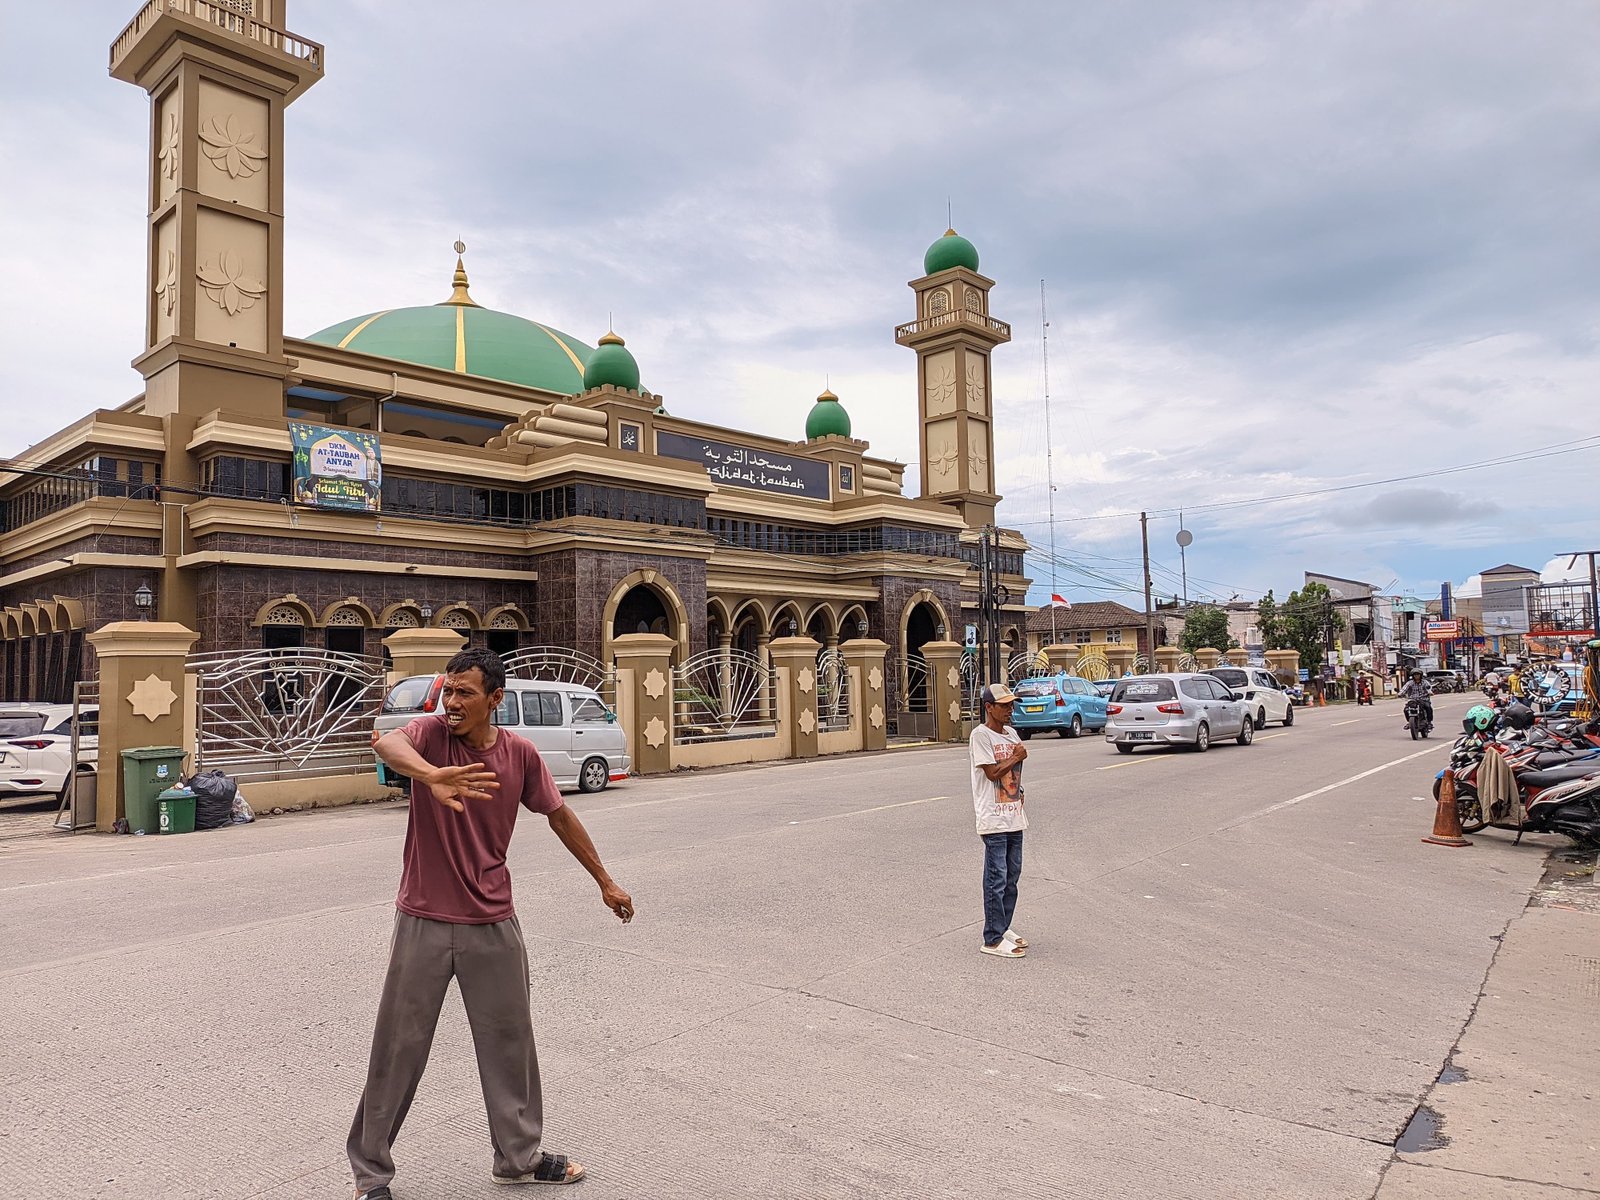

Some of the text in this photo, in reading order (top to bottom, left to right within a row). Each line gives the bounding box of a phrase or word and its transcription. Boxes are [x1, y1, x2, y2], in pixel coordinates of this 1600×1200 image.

[318, 449, 360, 459] AT-TAUBAH
[326, 458, 352, 466] ANYAR
[315, 484, 366, 497] Idul Fitri
[1520, 664, 1552, 692] TAMBAL
